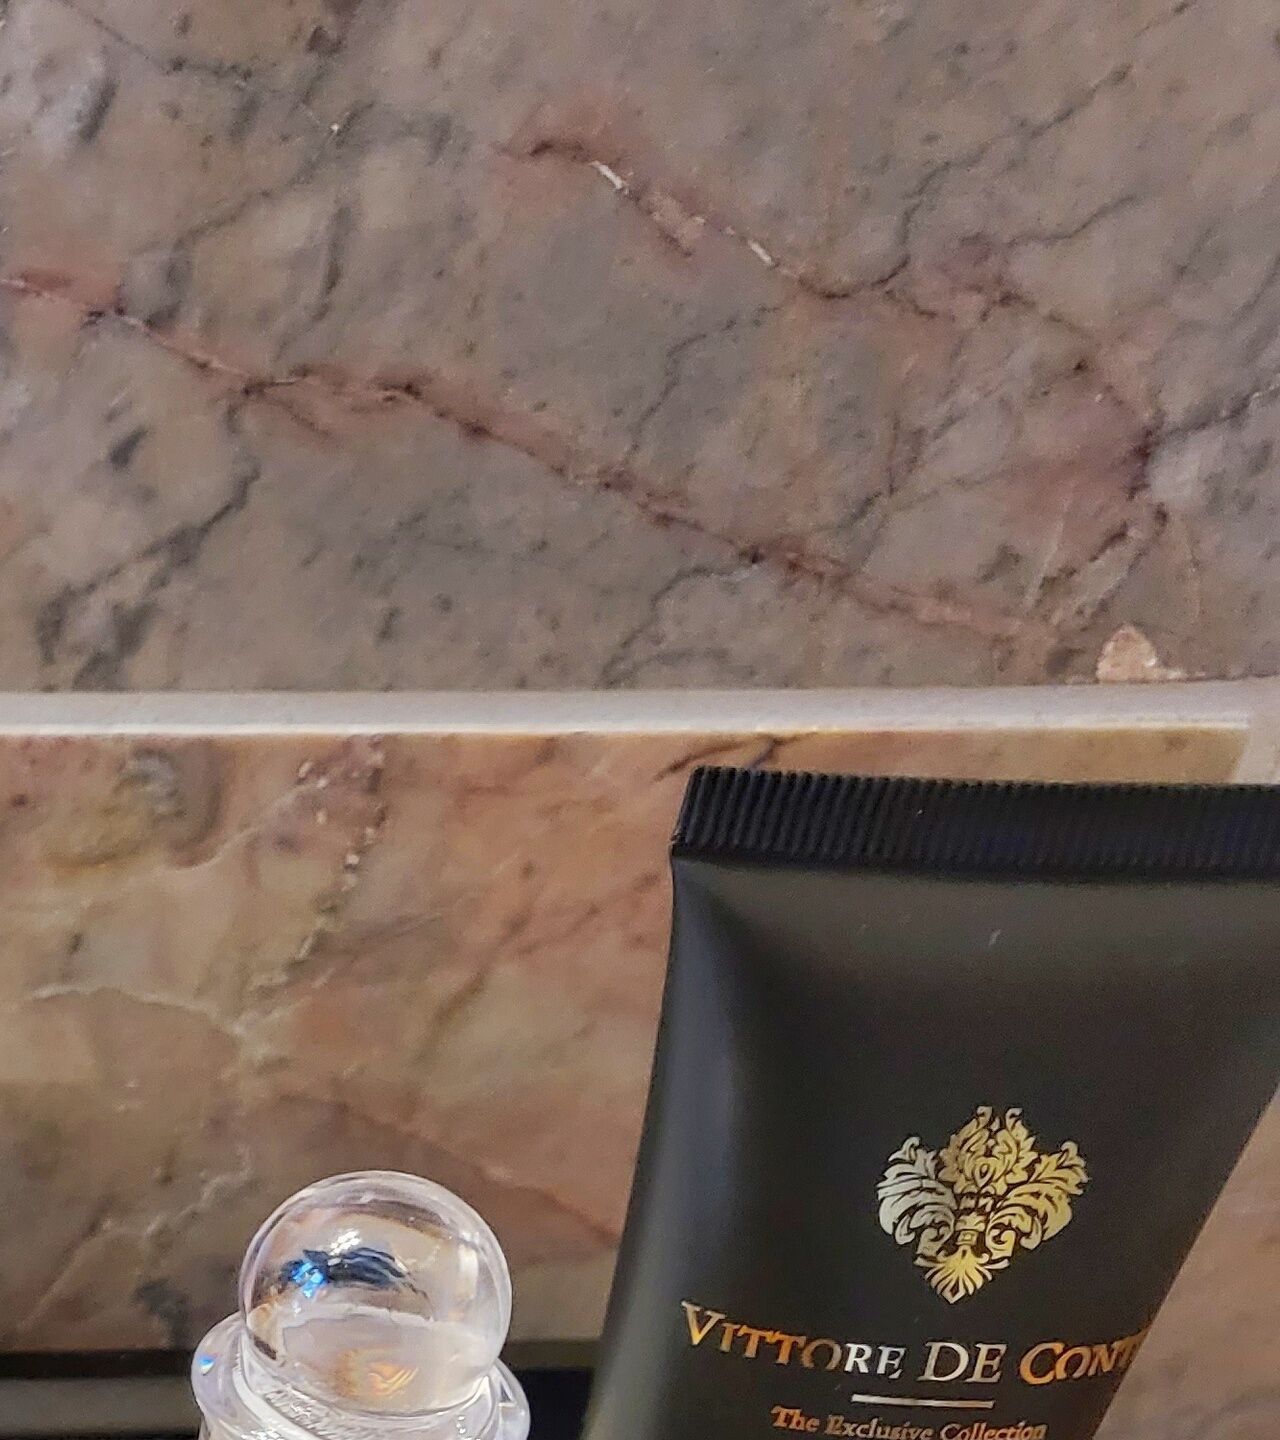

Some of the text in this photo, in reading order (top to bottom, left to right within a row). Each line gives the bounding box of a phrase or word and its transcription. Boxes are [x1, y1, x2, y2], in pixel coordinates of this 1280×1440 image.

[680, 1299, 909, 1382] VITTORE
[915, 1341, 1007, 1384] DE
[771, 1404, 819, 1435] The
